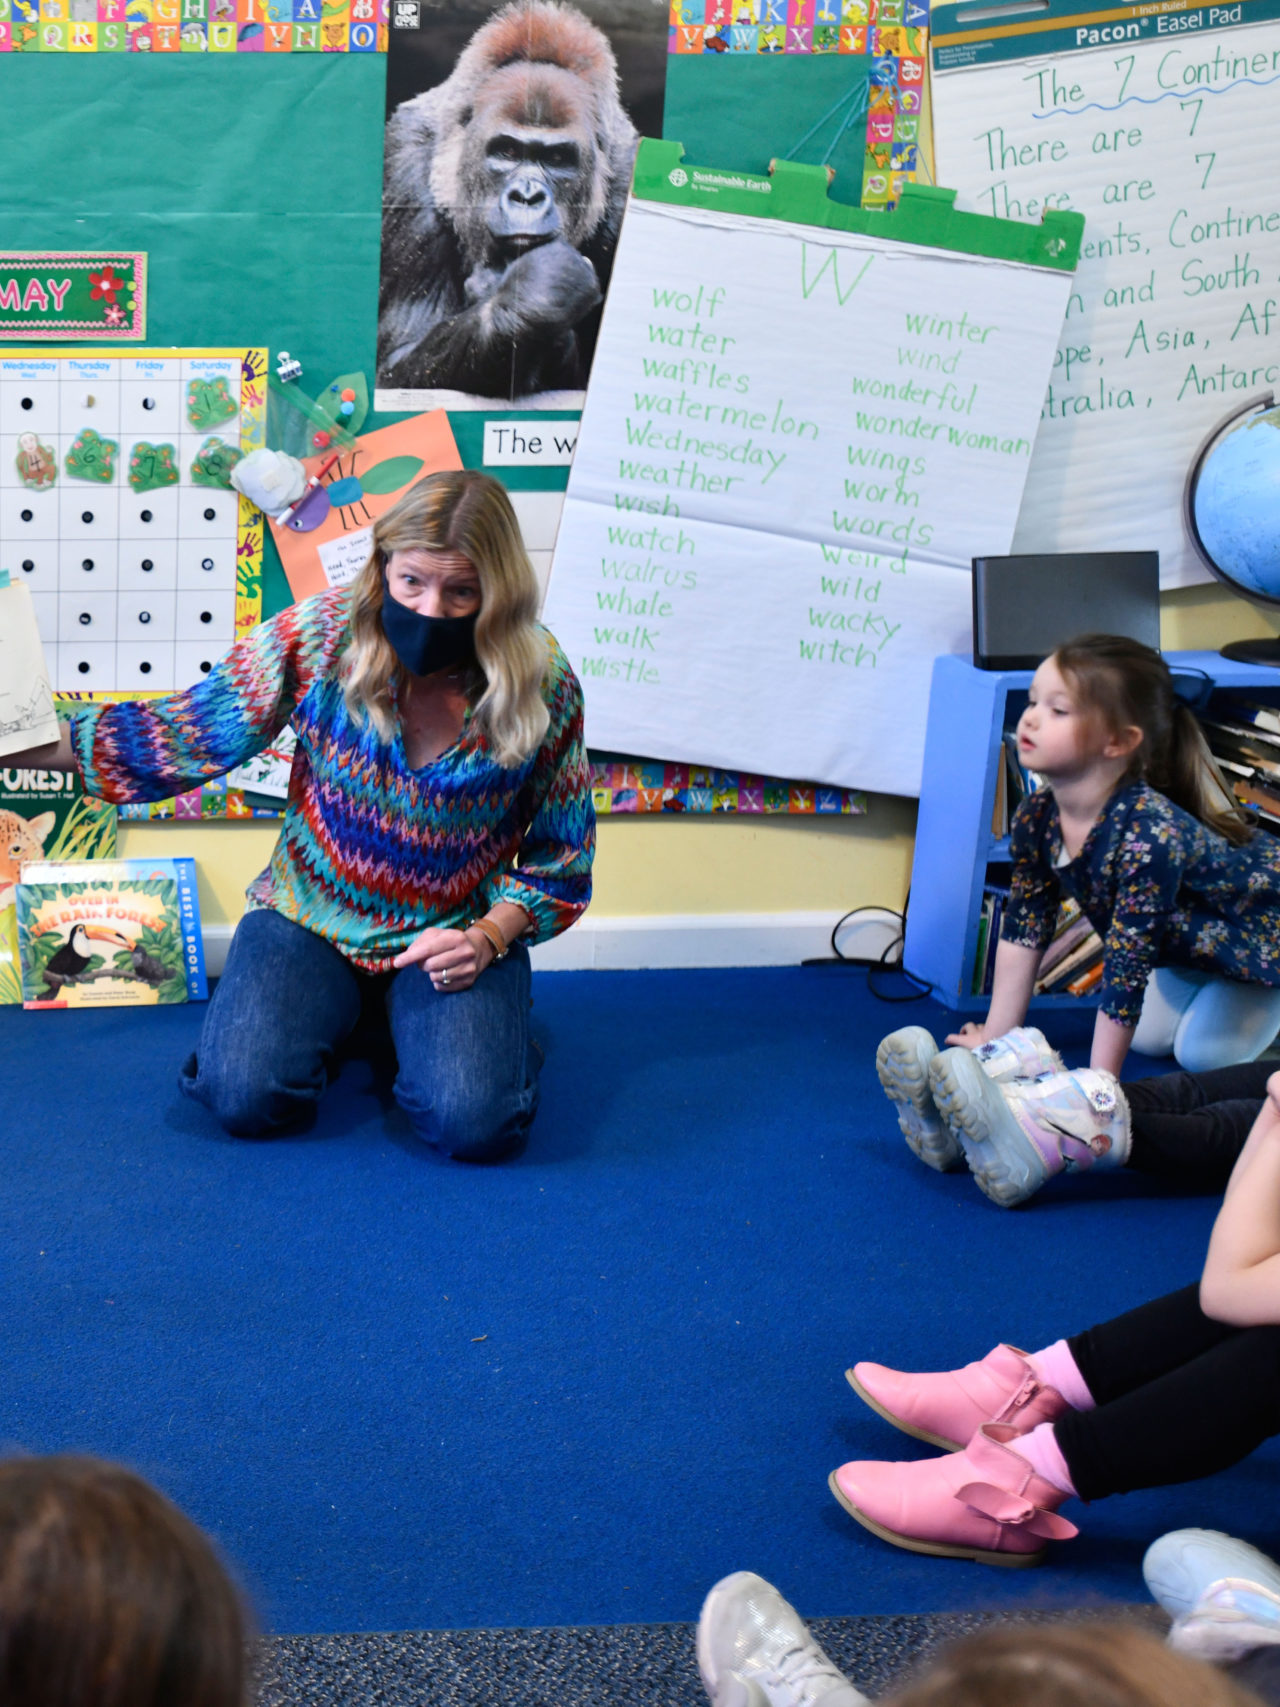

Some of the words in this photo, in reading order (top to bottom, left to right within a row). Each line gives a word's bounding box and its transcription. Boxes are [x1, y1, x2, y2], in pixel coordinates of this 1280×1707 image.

[1140, 5, 1159, 15] Inch
[1162, 0, 1187, 11] Ruled
[1157, 11, 1203, 33] Easel
[1209, 4, 1242, 25] Pad
[1023, 69, 1085, 109] The
[1114, 55, 1135, 103] 7
[973, 127, 1069, 172] There
[1091, 128, 1143, 155] are
[1180, 99, 1204, 138] 7
[693, 171, 746, 187] Sustainable
[746, 179, 772, 193] Earth
[977, 181, 1075, 219] There
[1103, 179, 1156, 205] are
[1195, 152, 1216, 190] 7
[1079, 222, 1150, 260] ents,
[801, 242, 875, 306] W
[1103, 270, 1155, 308] and
[1181, 252, 1260, 297] South
[653, 285, 726, 317] wolf
[649, 322, 736, 355] water
[906, 312, 1000, 344] winter
[1124, 319, 1210, 359] Asia,
[2, 361, 57, 372] Wednesday
[69, 361, 111, 372] Thursday
[135, 361, 164, 372] Friday
[189, 361, 232, 372] Saturday
[642, 357, 750, 394] waffles
[898, 347, 963, 374] wind
[852, 376, 978, 416] wonderful
[634, 390, 819, 440] watermelon
[492, 428, 542, 454] The
[625, 418, 787, 484] Wednesday
[29, 455, 41, 472] 4
[83, 446, 96, 464] 6
[145, 455, 156, 479] 7
[619, 459, 745, 493] weather
[847, 445, 926, 489] wings
[614, 493, 680, 518] wish
[844, 479, 920, 508] worm
[608, 526, 696, 556] watch
[832, 510, 934, 546] words
[601, 557, 698, 590] walrus
[820, 543, 909, 575] weird
[597, 586, 673, 617] whale
[821, 576, 882, 602] wild
[593, 625, 660, 651] walk
[809, 607, 902, 651] wacky
[799, 639, 877, 668] witch
[181, 887, 193, 918] BEST
[186, 935, 199, 974] BOOK
